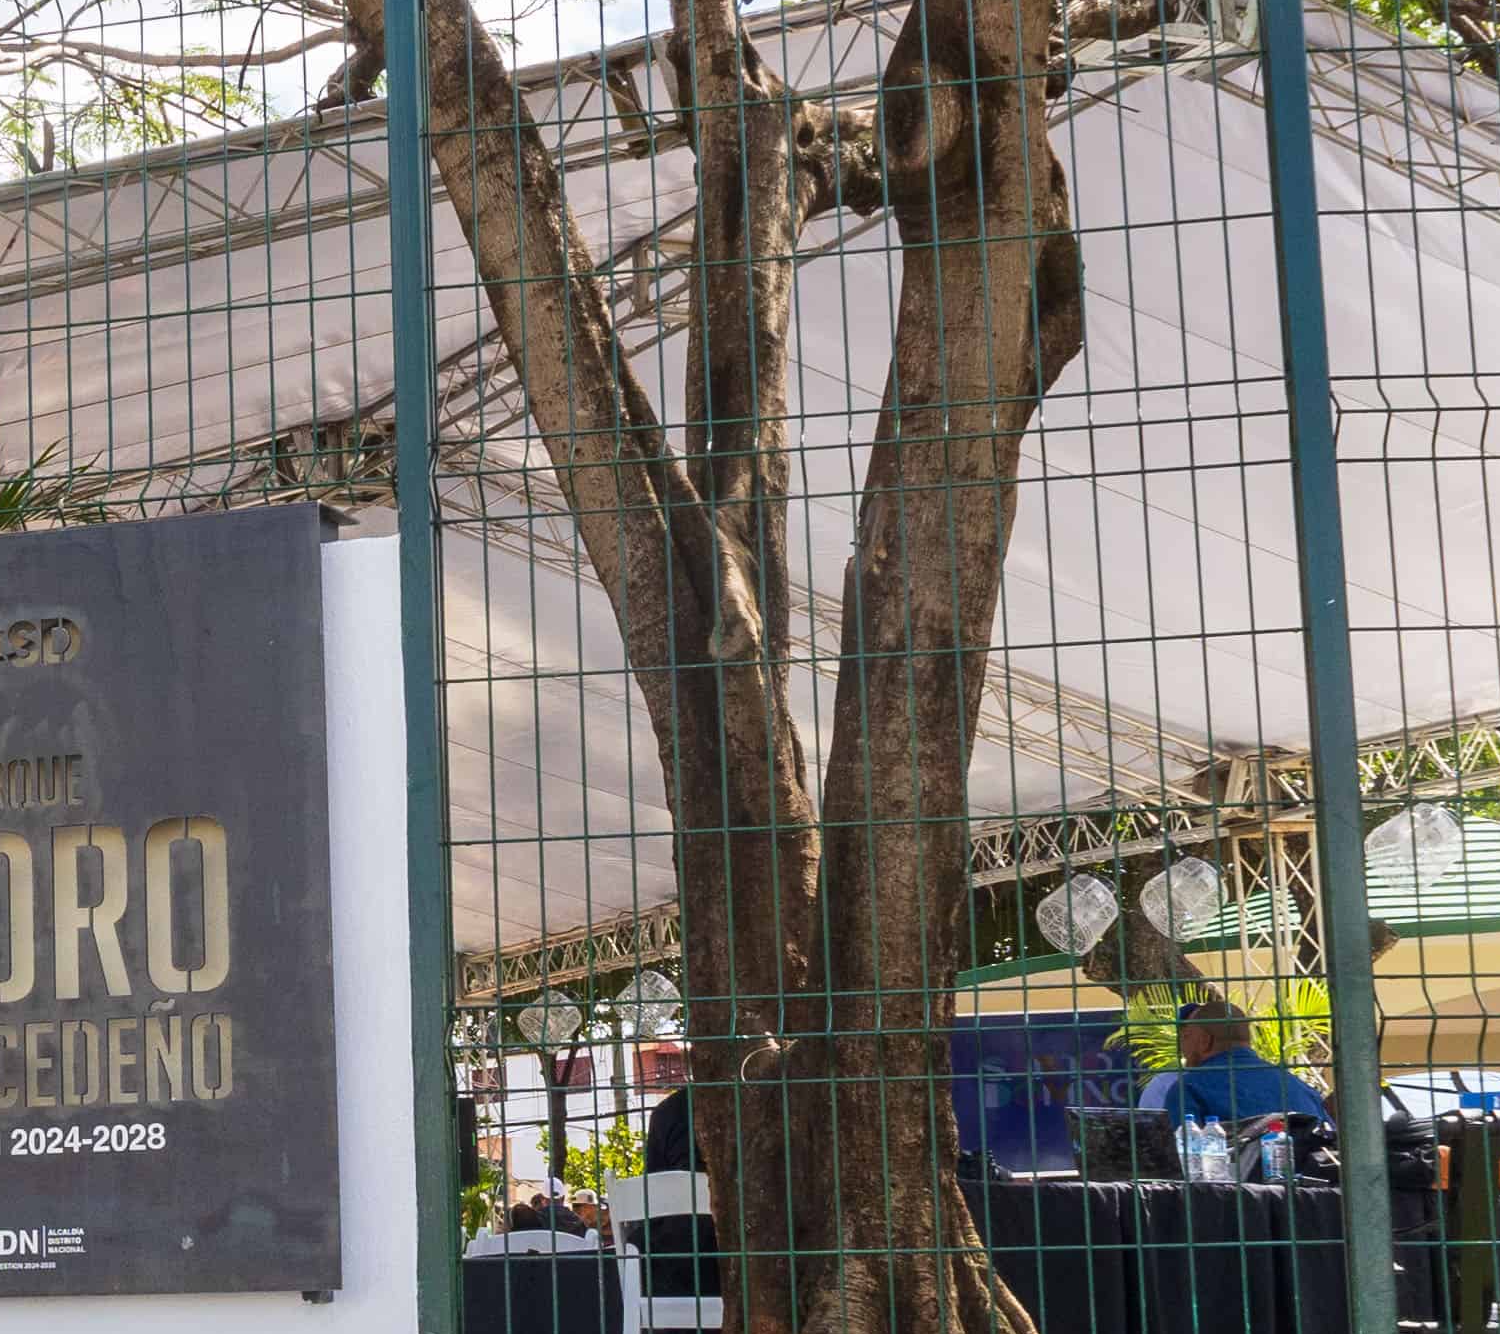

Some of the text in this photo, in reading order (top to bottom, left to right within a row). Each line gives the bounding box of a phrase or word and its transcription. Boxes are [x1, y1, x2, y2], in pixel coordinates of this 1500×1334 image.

[10, 1123, 166, 1155] 2024-2028
[48, 1237, 82, 1245] DISTRITO
[48, 1245, 86, 1254] NACIONAL
